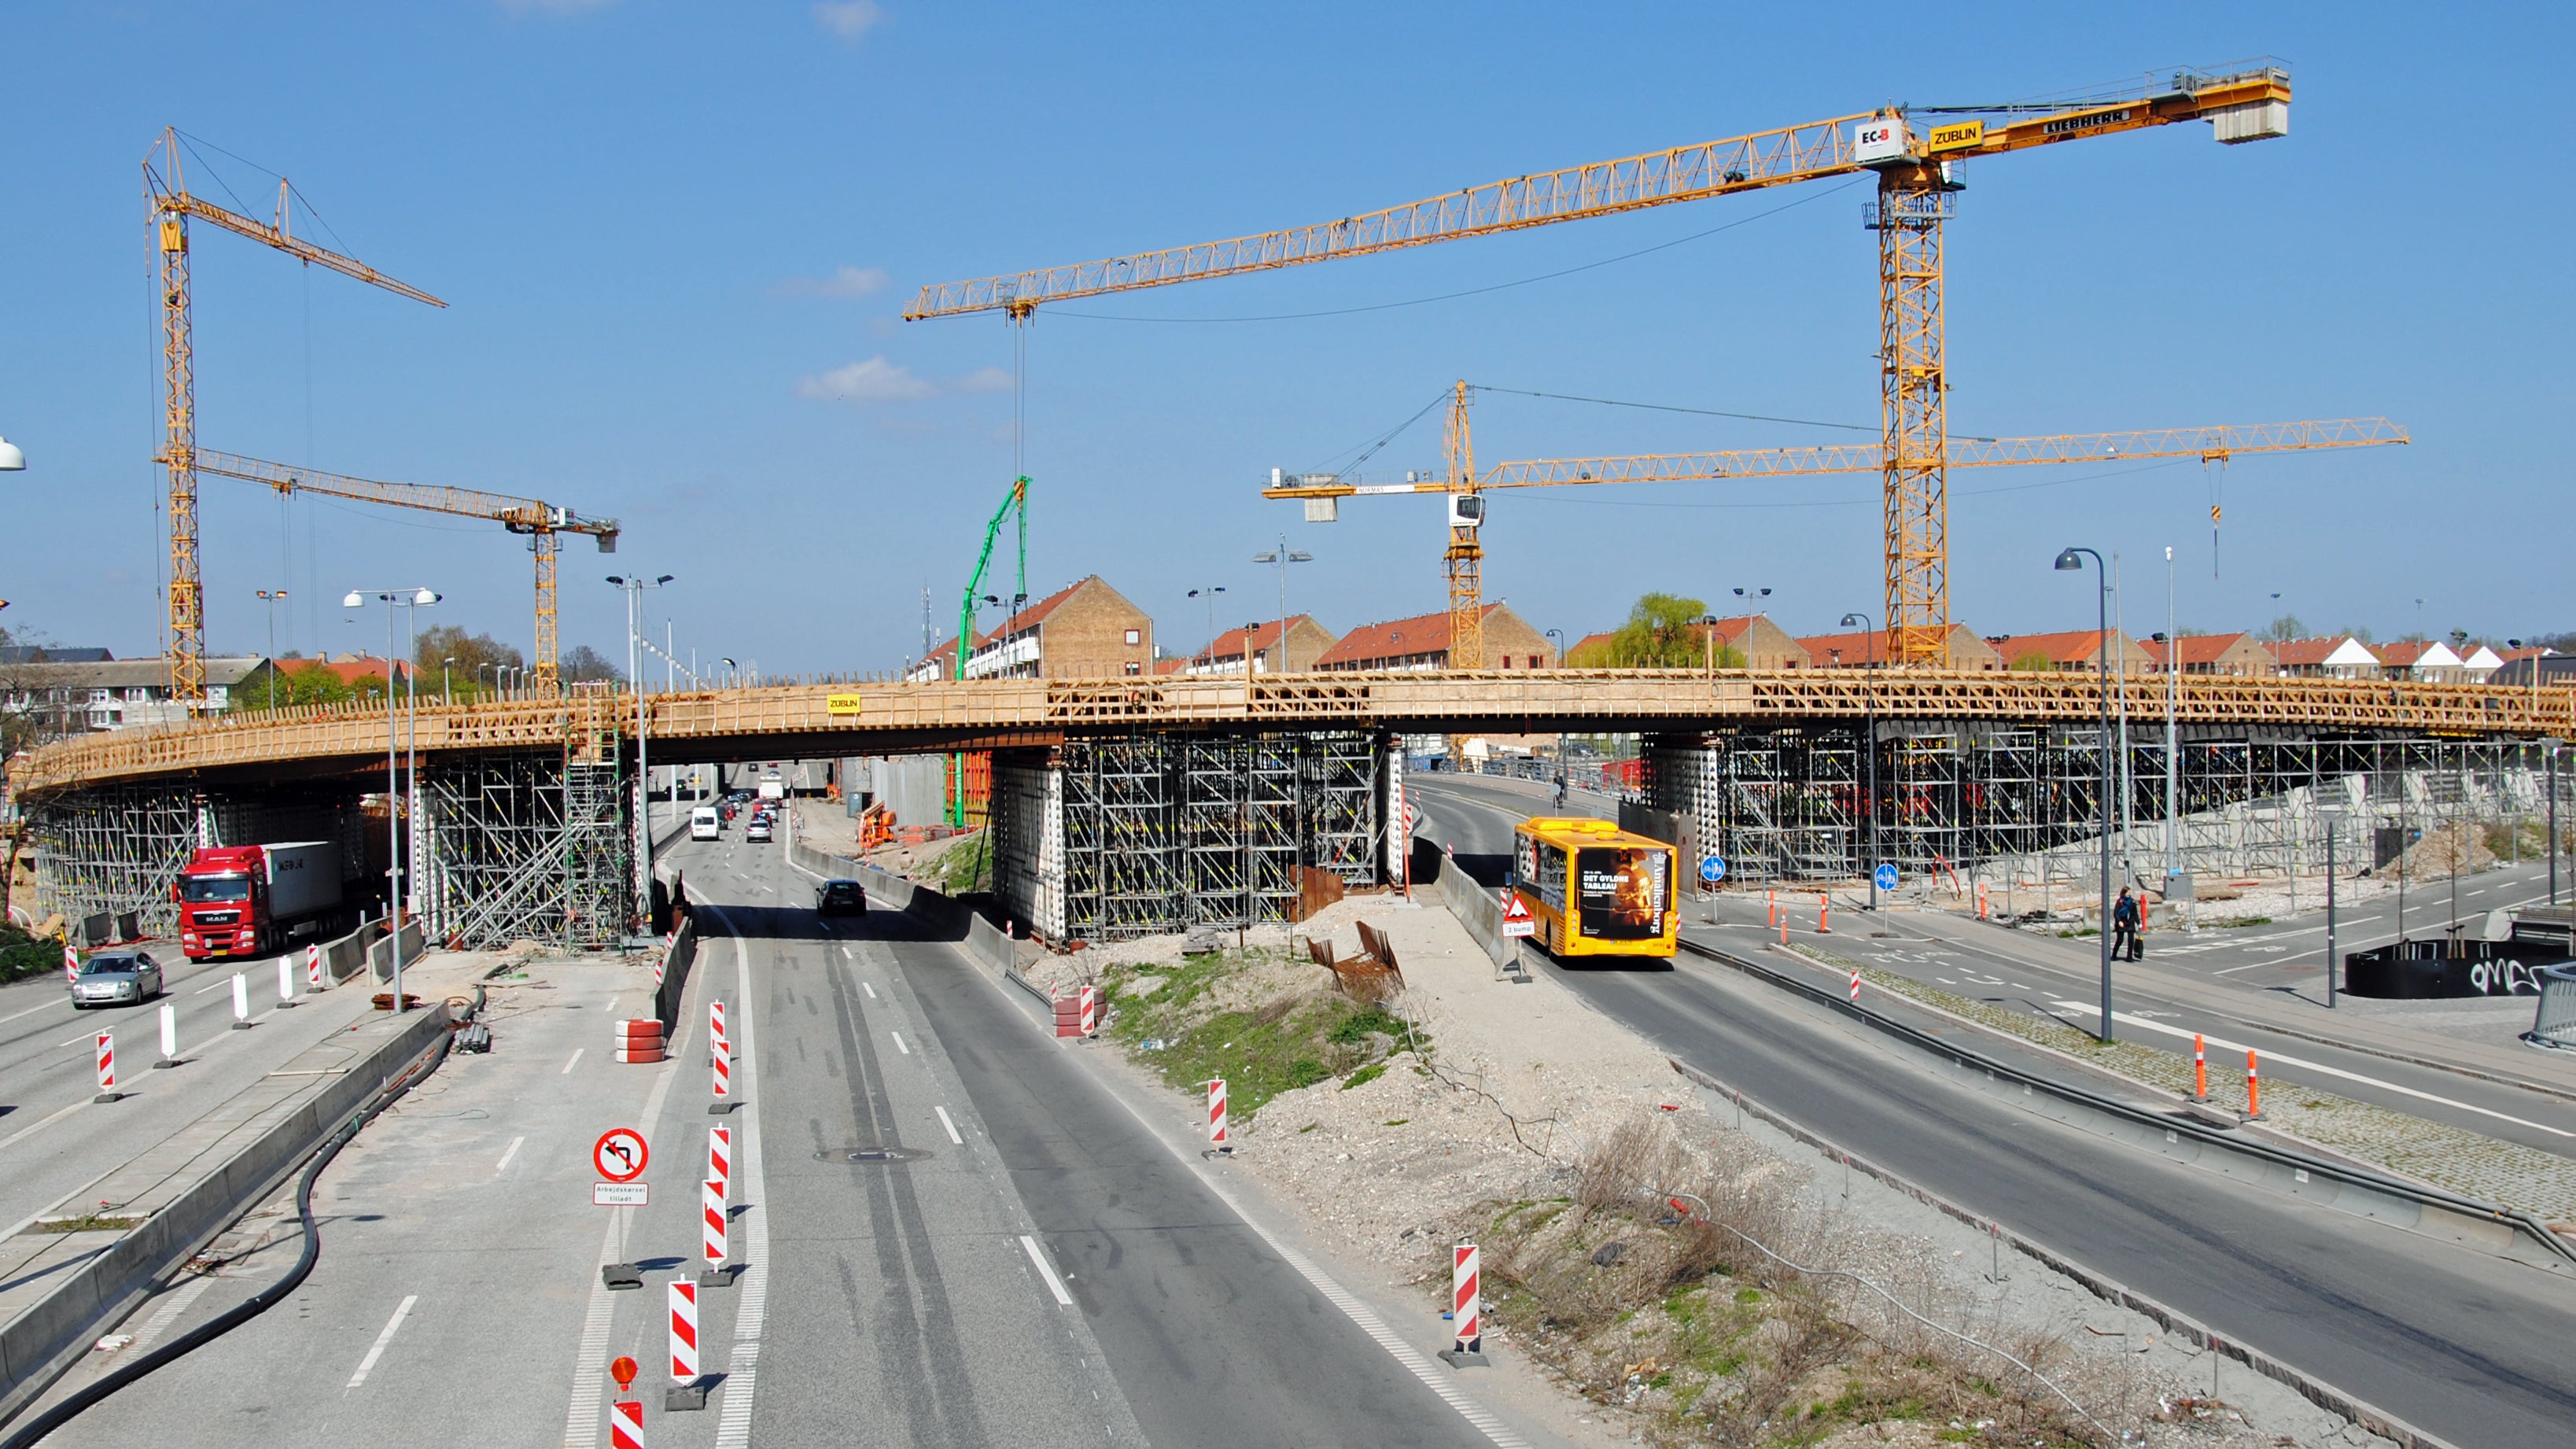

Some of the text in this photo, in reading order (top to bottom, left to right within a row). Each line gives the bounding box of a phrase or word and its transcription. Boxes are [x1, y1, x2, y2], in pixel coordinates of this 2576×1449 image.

[2047, 112, 2123, 133] LIEBHERR
[1862, 128, 1889, 144] EC-B
[1650, 864, 1664, 935] Amalienborg
